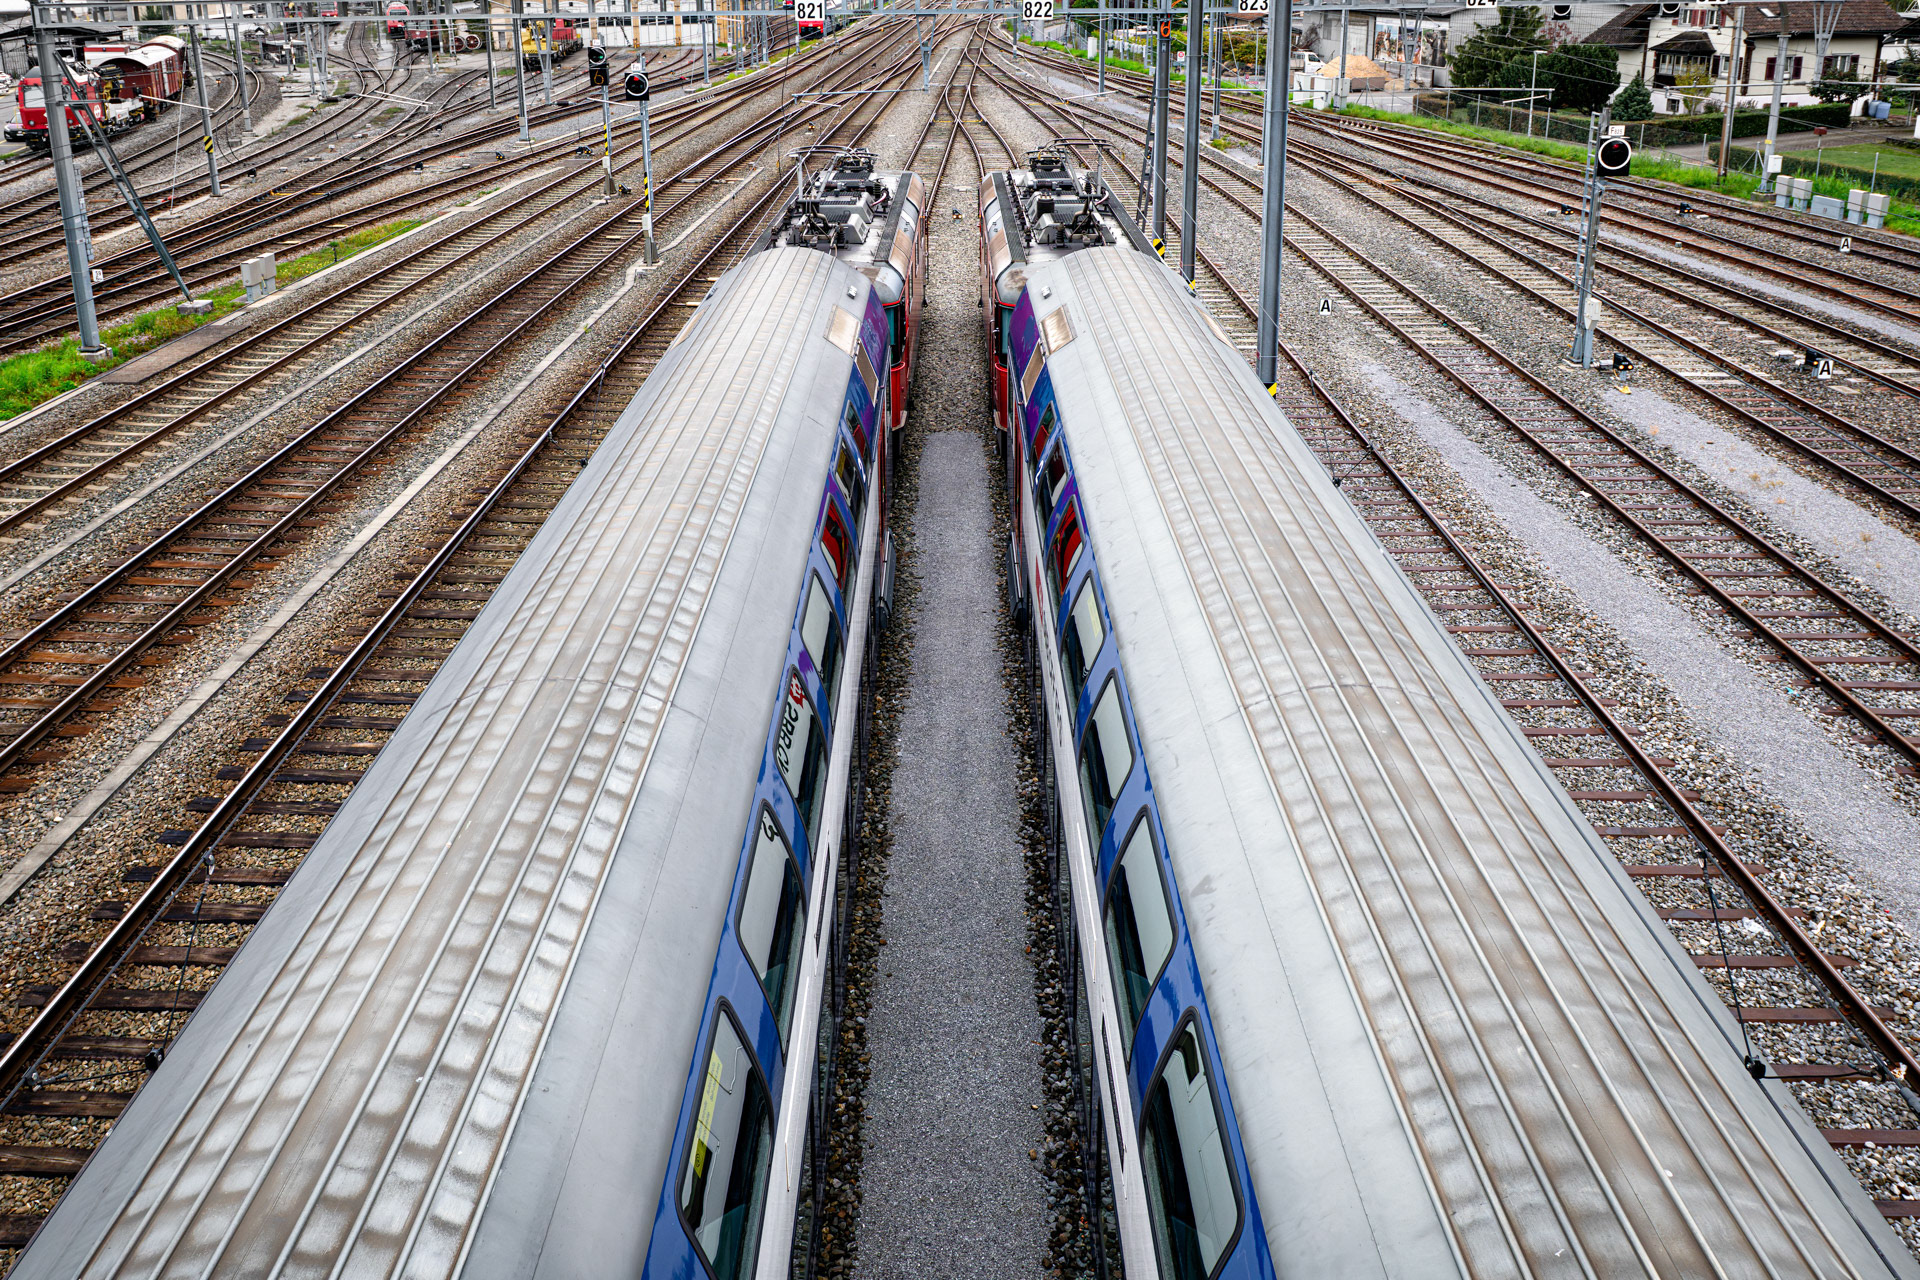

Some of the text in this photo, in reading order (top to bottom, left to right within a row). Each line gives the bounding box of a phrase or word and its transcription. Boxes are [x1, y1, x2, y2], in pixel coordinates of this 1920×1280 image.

[797, 2, 823, 19] 821
[1024, 1, 1052, 17] 822
[1240, 0, 1268, 11] 823
[594, 69, 604, 85] 6
[1841, 238, 1849, 249] A
[1320, 299, 1330, 312] A
[1819, 360, 1830, 375] A
